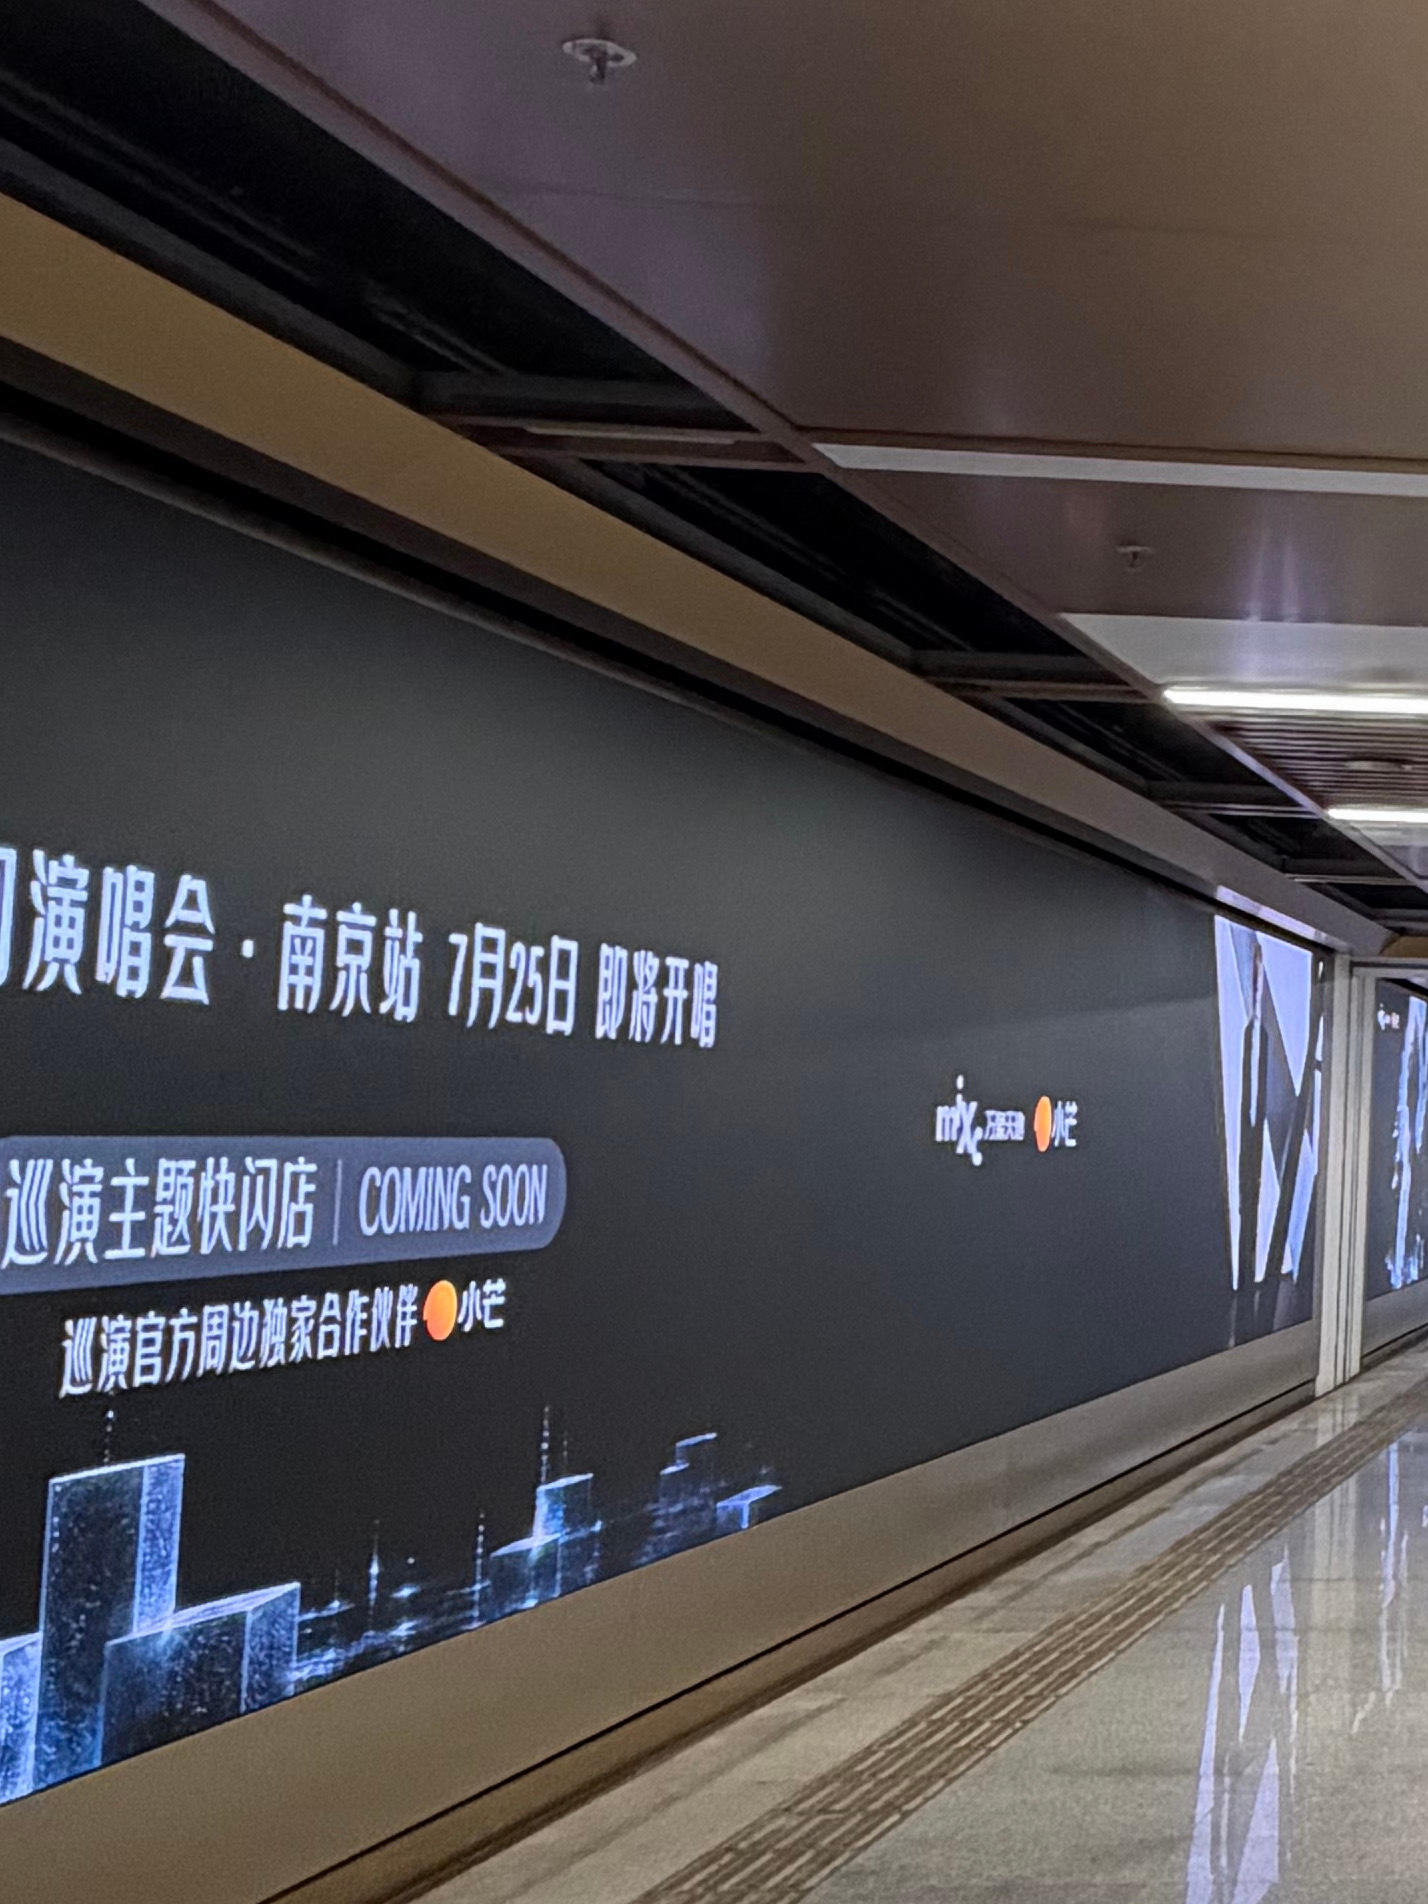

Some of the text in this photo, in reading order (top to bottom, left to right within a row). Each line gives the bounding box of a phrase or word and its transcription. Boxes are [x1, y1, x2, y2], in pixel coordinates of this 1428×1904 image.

[448, 922, 579, 1036] 7月25日
[595, 942, 719, 1049] 即将开唱
[1, 1156, 548, 1269] 巡演主题快闪店 COMING SOON
[58, 1278, 507, 1399] 巡演官方周边独家合作伙伴 小芒
